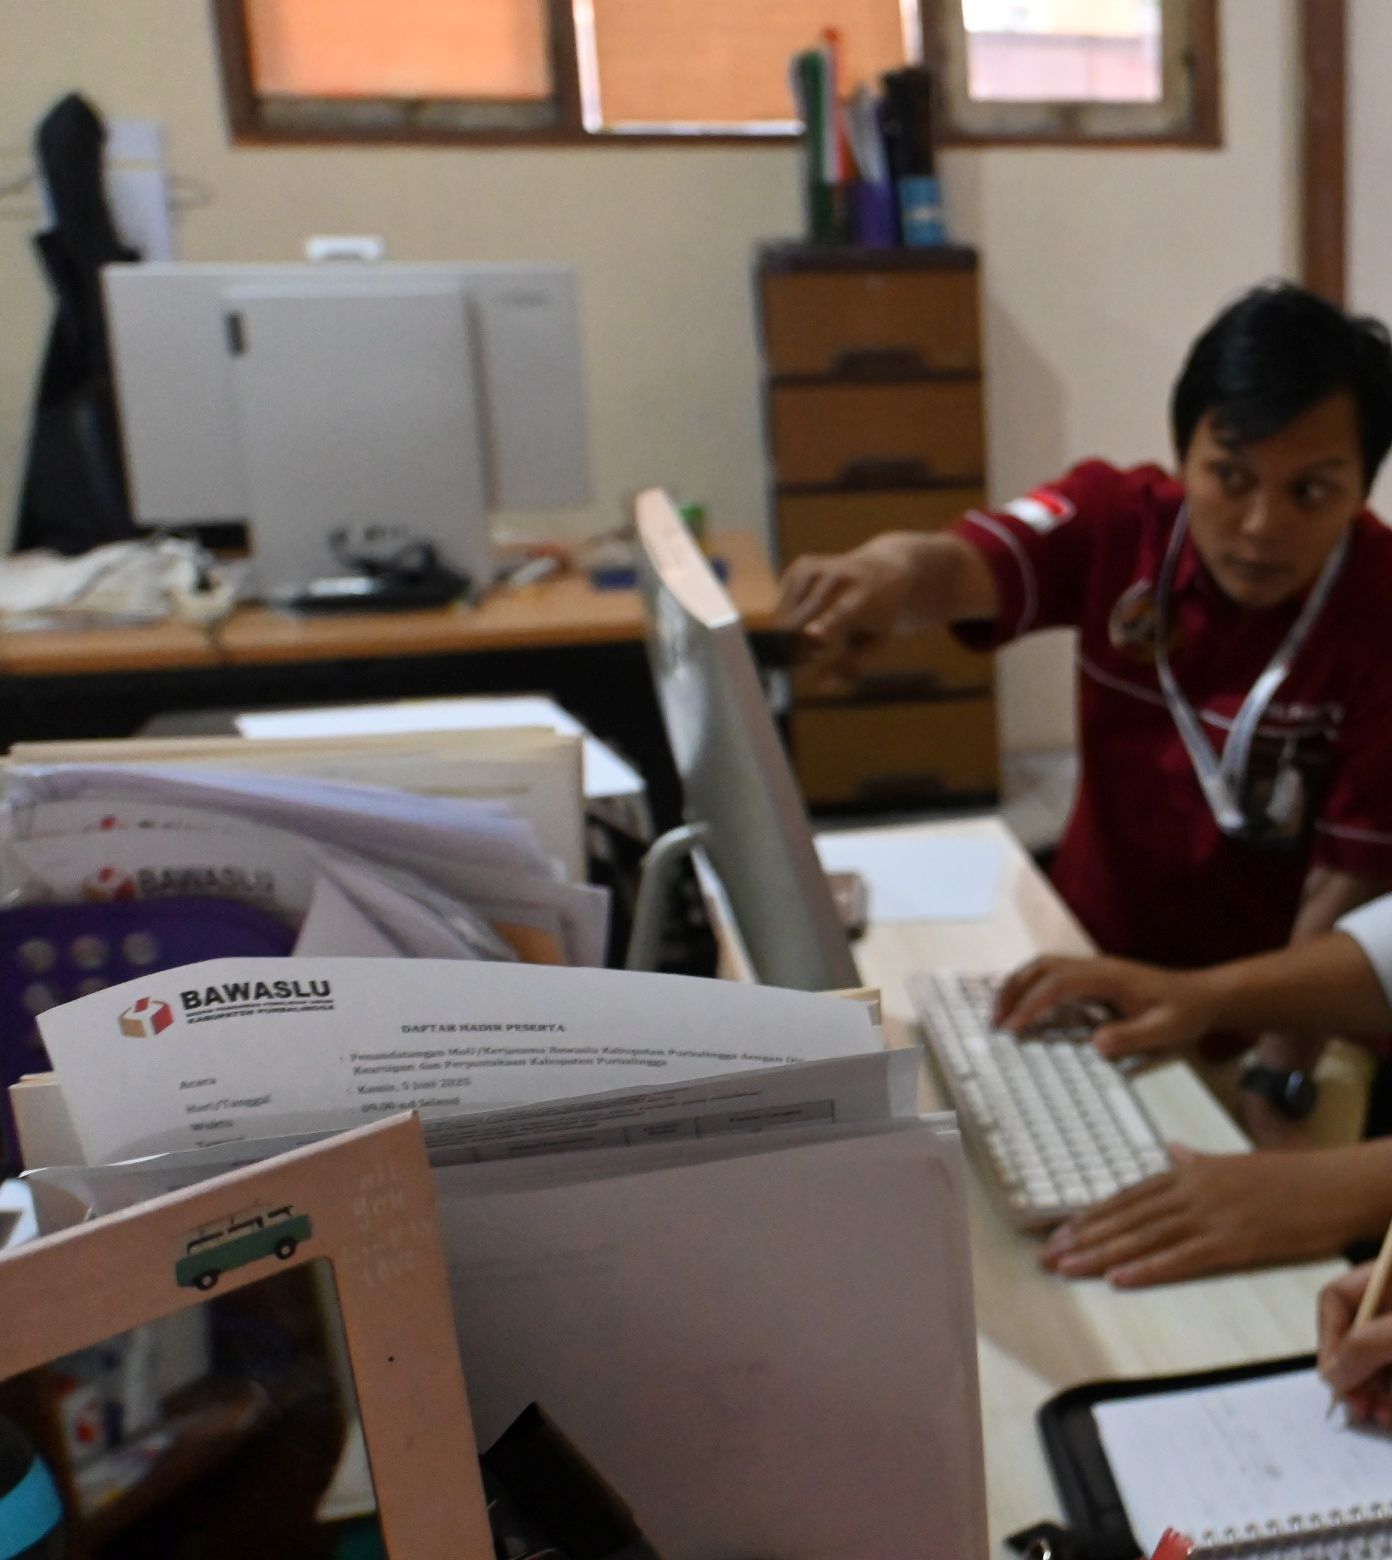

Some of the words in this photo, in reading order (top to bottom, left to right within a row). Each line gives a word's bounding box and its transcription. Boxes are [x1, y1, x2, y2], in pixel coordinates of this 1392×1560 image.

[180, 979, 331, 1010] BAWASLU
[400, 1023, 457, 1033] DAFTAR
[459, 1023, 502, 1032] HADIR
[505, 1023, 566, 1033] PESERTA
[601, 1047, 664, 1056] Kabupaten
[668, 1049, 737, 1060] Purbalingga
[529, 1056, 593, 1067] Kabupaten
